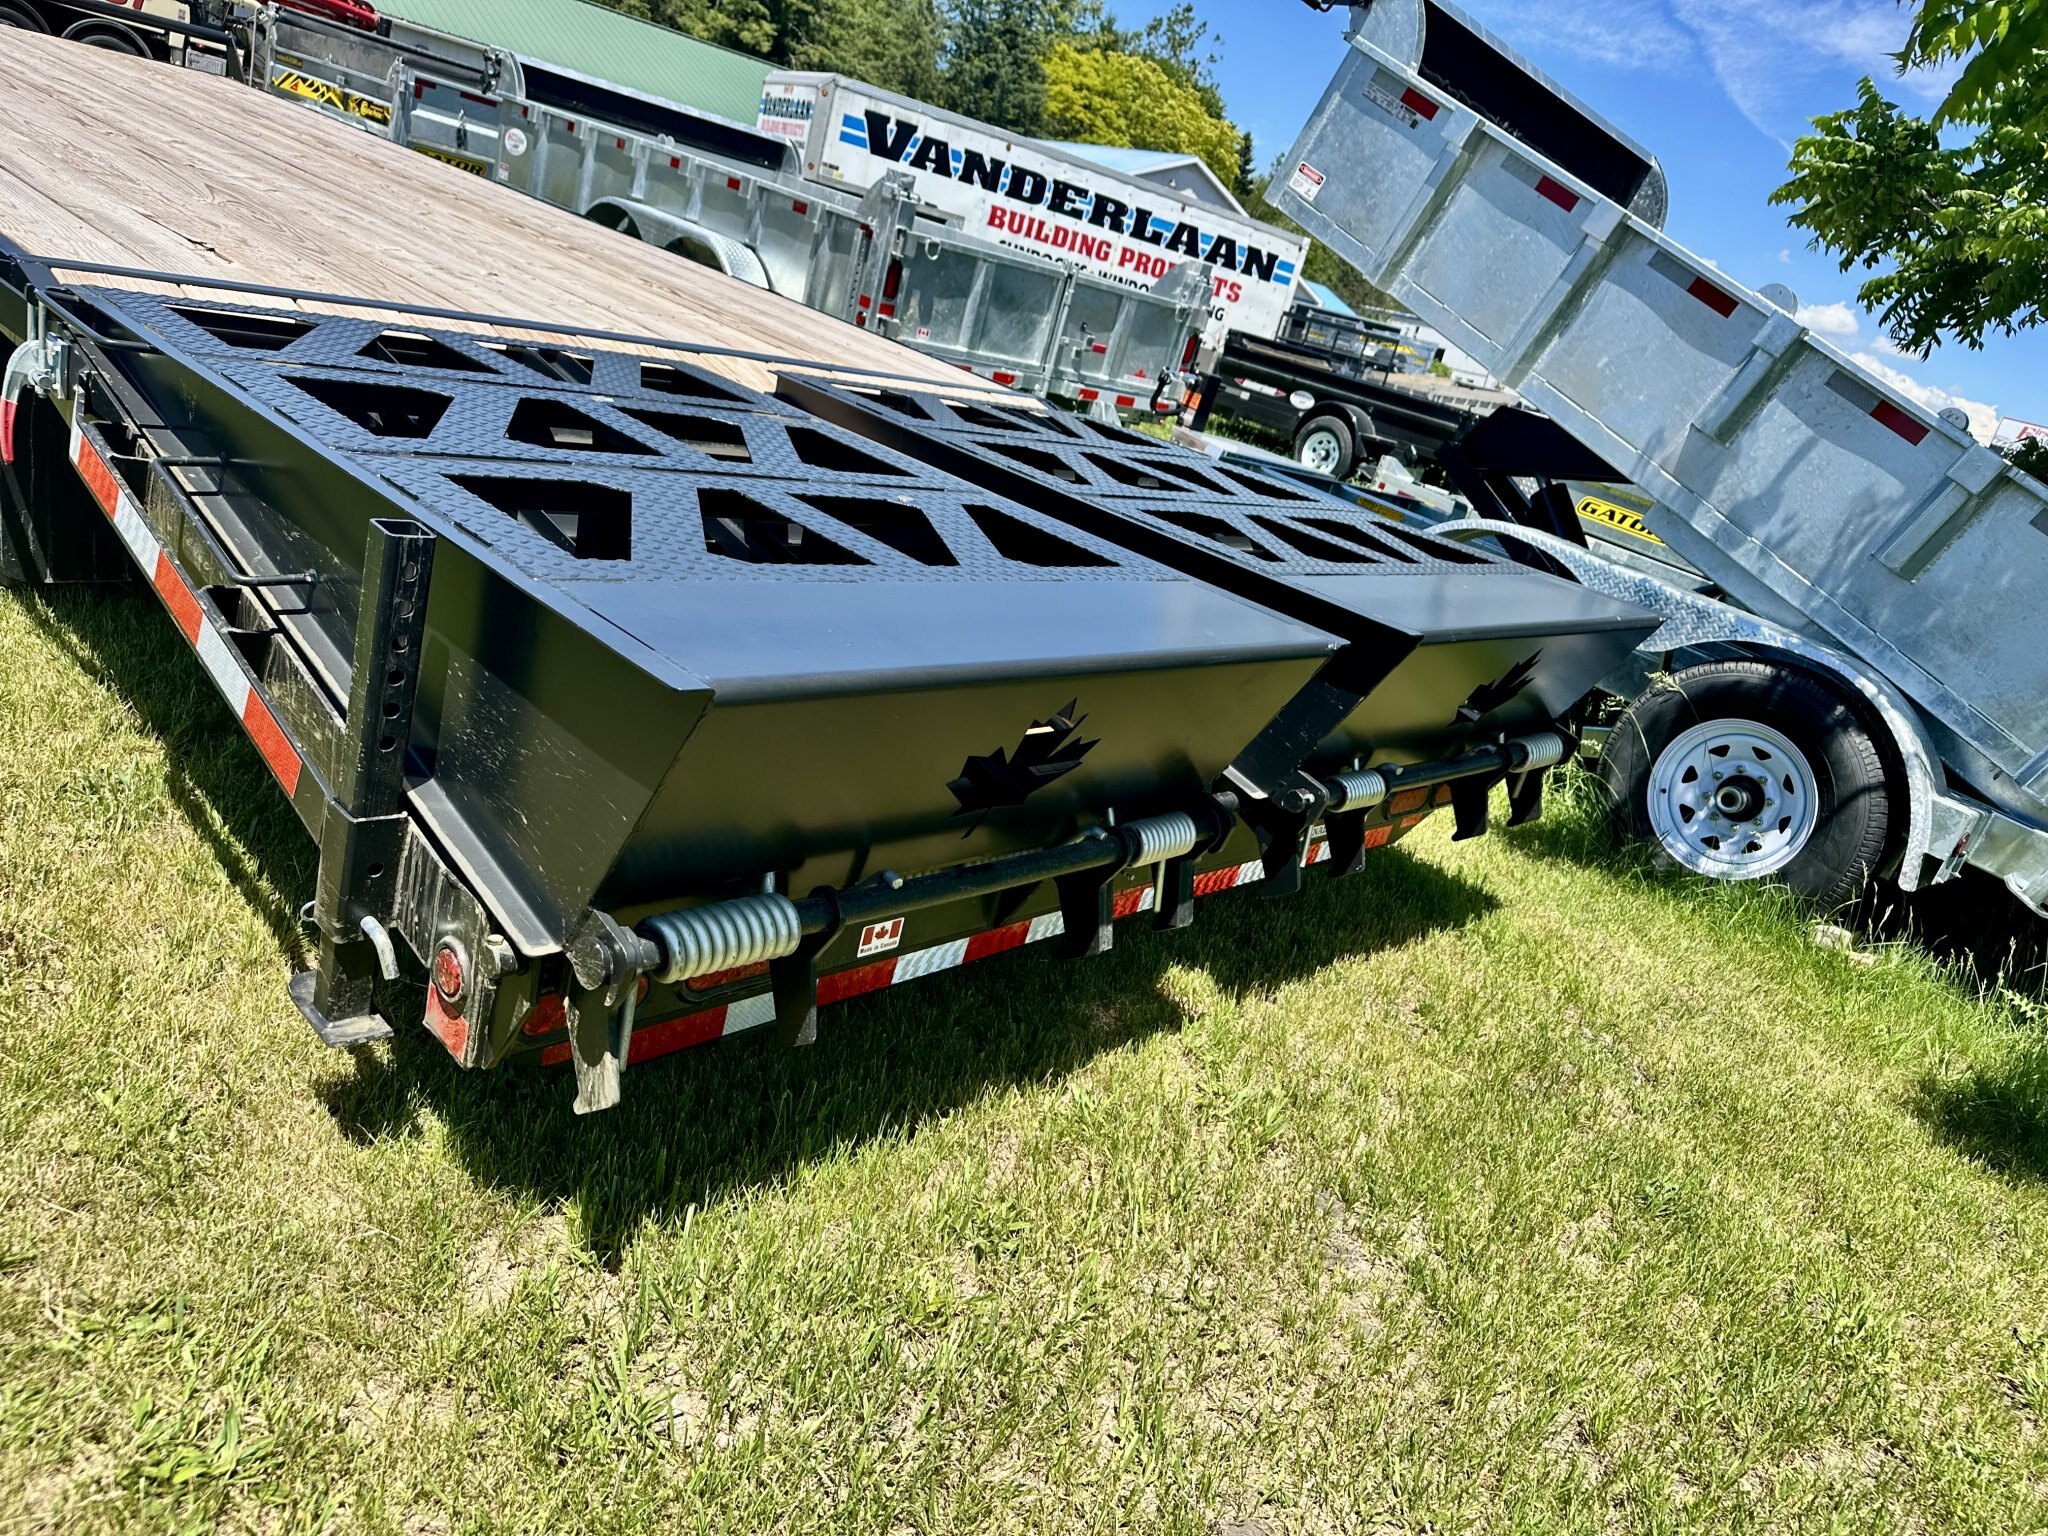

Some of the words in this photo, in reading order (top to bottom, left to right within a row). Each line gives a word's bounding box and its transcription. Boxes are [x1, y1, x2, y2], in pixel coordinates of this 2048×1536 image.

[865, 109, 1279, 282] VANDERLAAN
[987, 205, 1112, 262] BUILDING
[1118, 246, 1242, 303] PROTS
[1581, 501, 1653, 536] GATO
[881, 940, 897, 948] Canada
